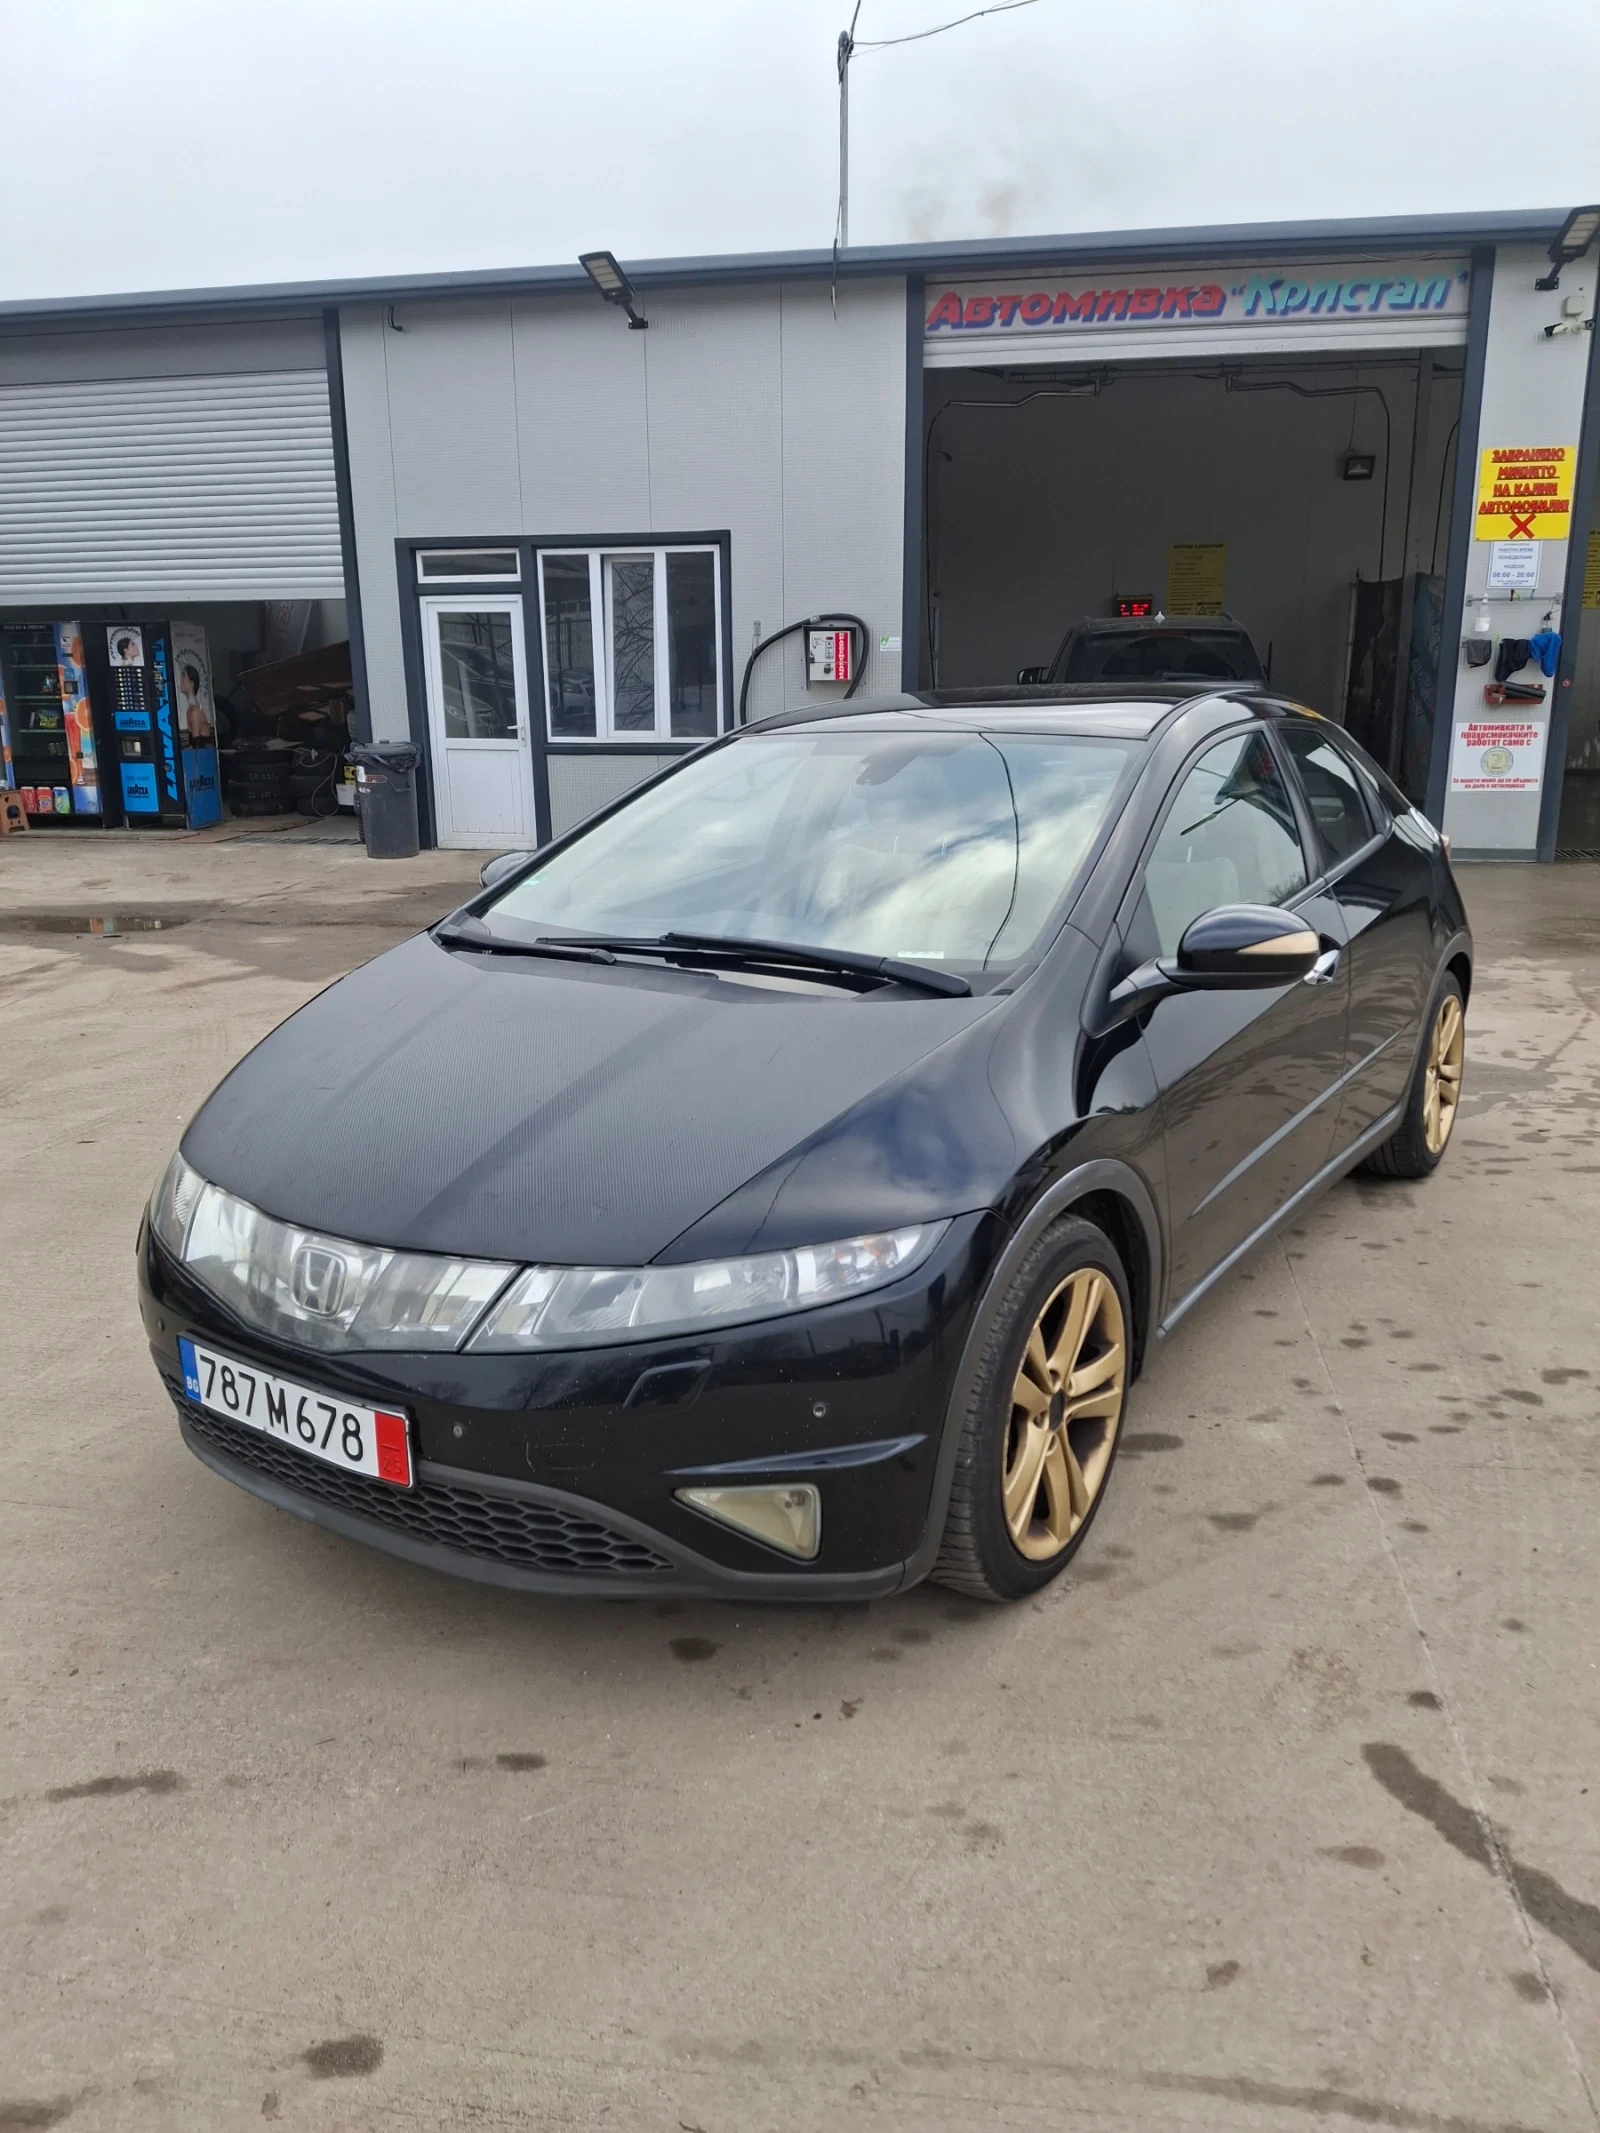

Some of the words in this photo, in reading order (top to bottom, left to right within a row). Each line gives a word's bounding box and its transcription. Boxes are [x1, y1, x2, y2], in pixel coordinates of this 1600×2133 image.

[1492, 448, 1565, 462] ЗАБРАНЕНО
[1497, 465, 1557, 479] МИЕНЕТО
[1494, 484, 1511, 496] НА
[1514, 483, 1558, 496] КАЛНИ
[1468, 723, 1525, 731] Автомивката
[1466, 738, 1500, 747] работят
[186, 1375, 199, 1393] BG
